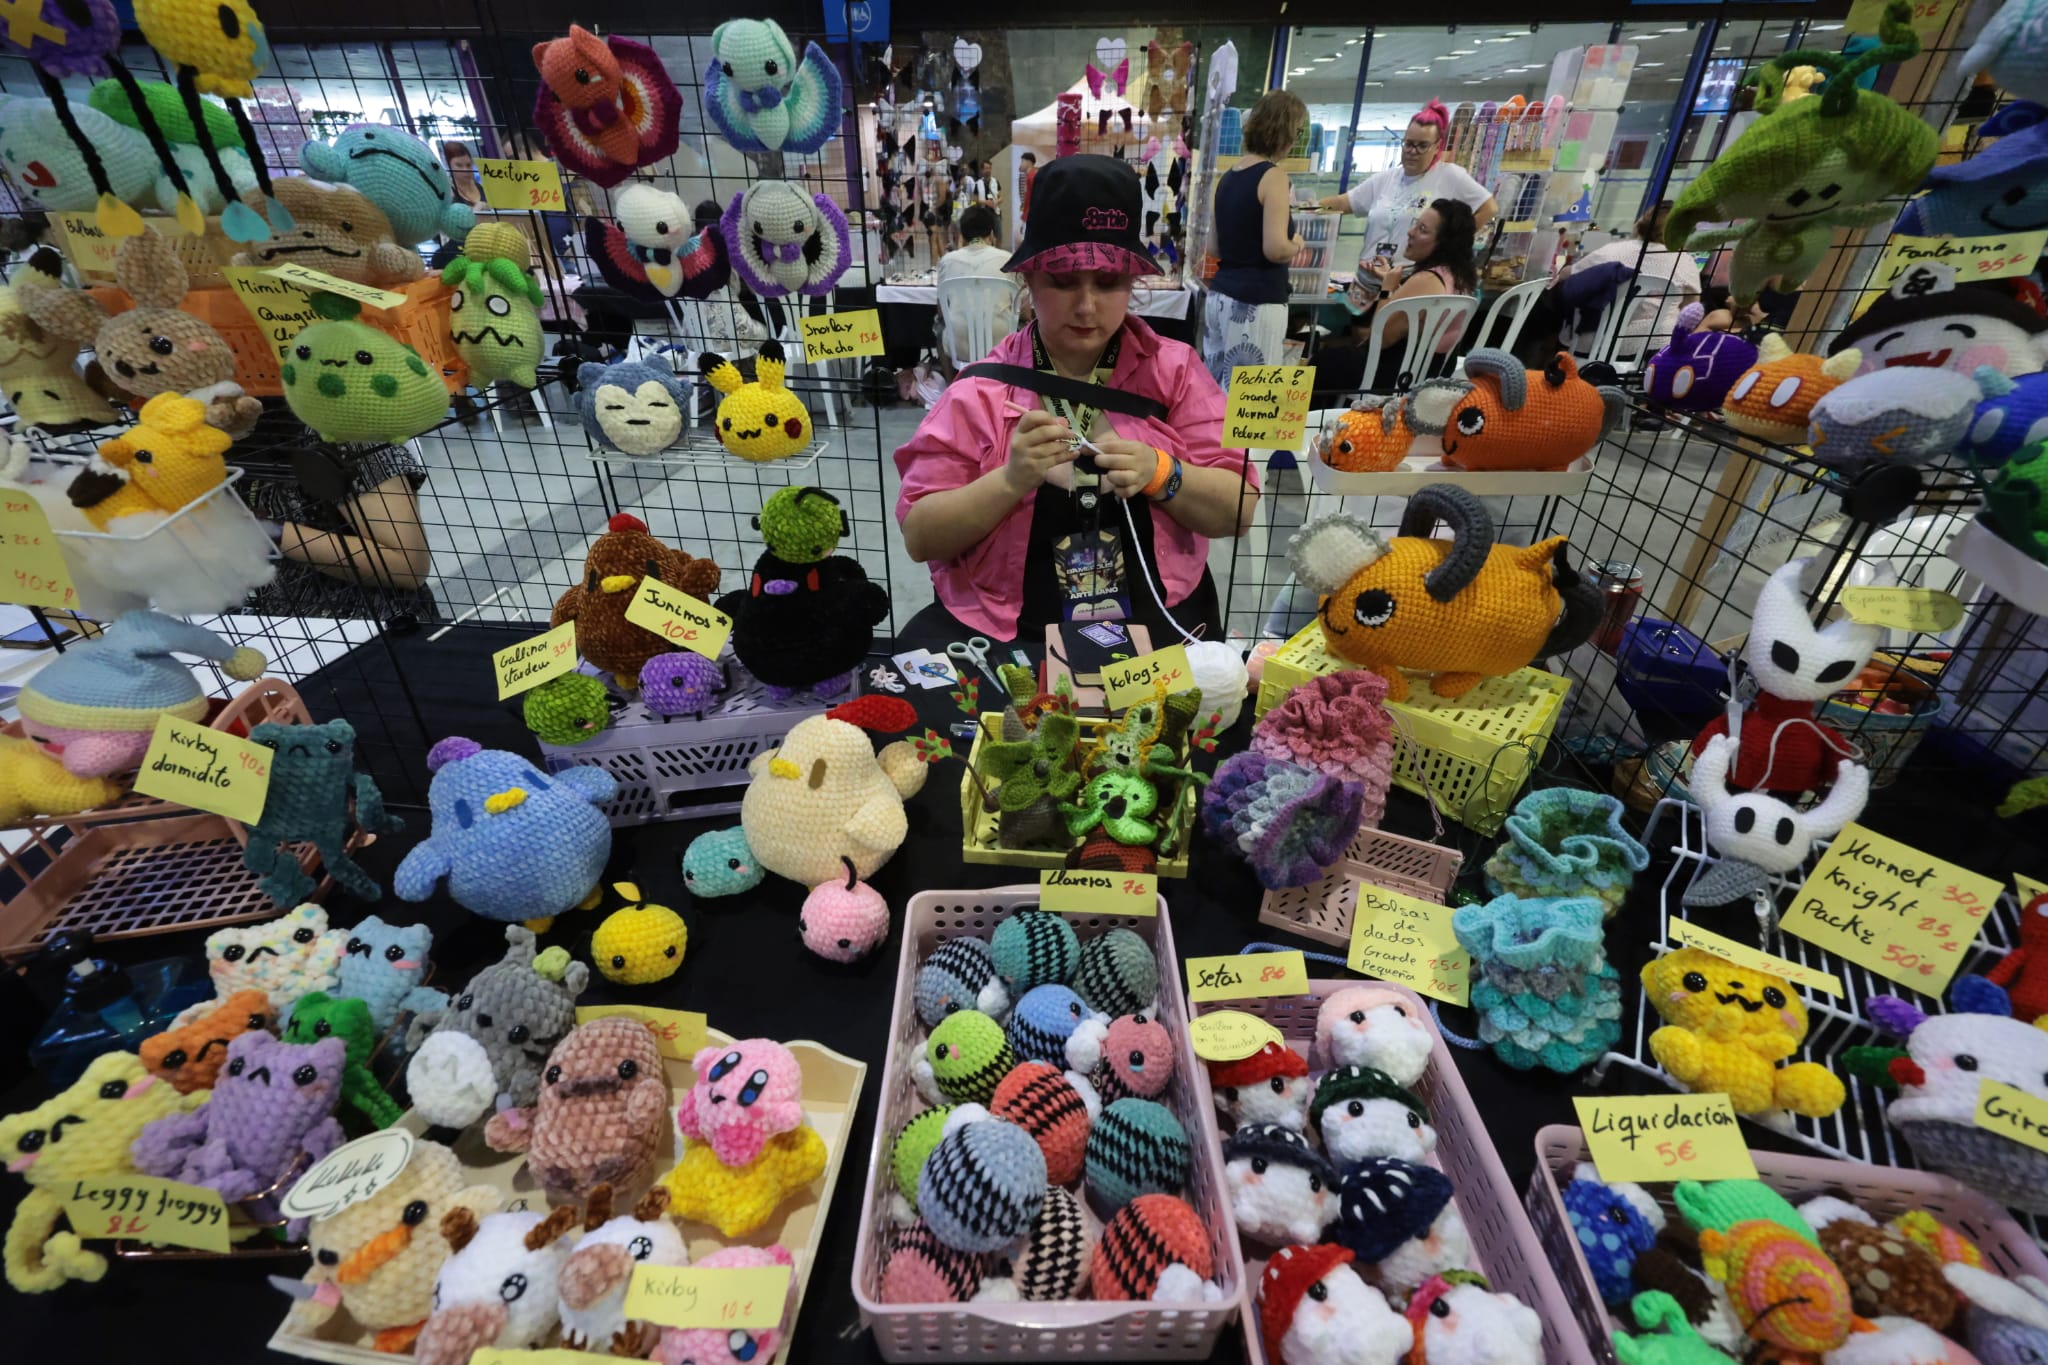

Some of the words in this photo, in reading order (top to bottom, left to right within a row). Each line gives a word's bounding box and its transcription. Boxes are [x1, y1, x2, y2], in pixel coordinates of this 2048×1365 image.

[1082, 206, 1129, 230] Barbie
[1235, 367, 1285, 385] Pochita
[1239, 389, 1279, 404] Grande
[1236, 405, 1280, 420] Normal
[644, 588, 711, 629] Junimos
[662, 620, 698, 641] 10€
[500, 641, 548, 668] Gallina
[1109, 661, 1161, 691] Kologs
[170, 729, 218, 766] Kirby
[151, 752, 232, 788] dormidito
[1838, 838, 1938, 888] Hornet
[1123, 880, 1147, 896] 7€
[1823, 866, 1920, 917] Knight
[1366, 893, 1431, 921] Bolsas
[1363, 923, 1425, 947] dados
[1394, 920, 1420, 932] de
[1655, 1139, 1698, 1167] 5€
[72, 1180, 149, 1213] Leggy
[155, 1188, 222, 1226] froggy
[644, 1274, 698, 1313] Kirby
